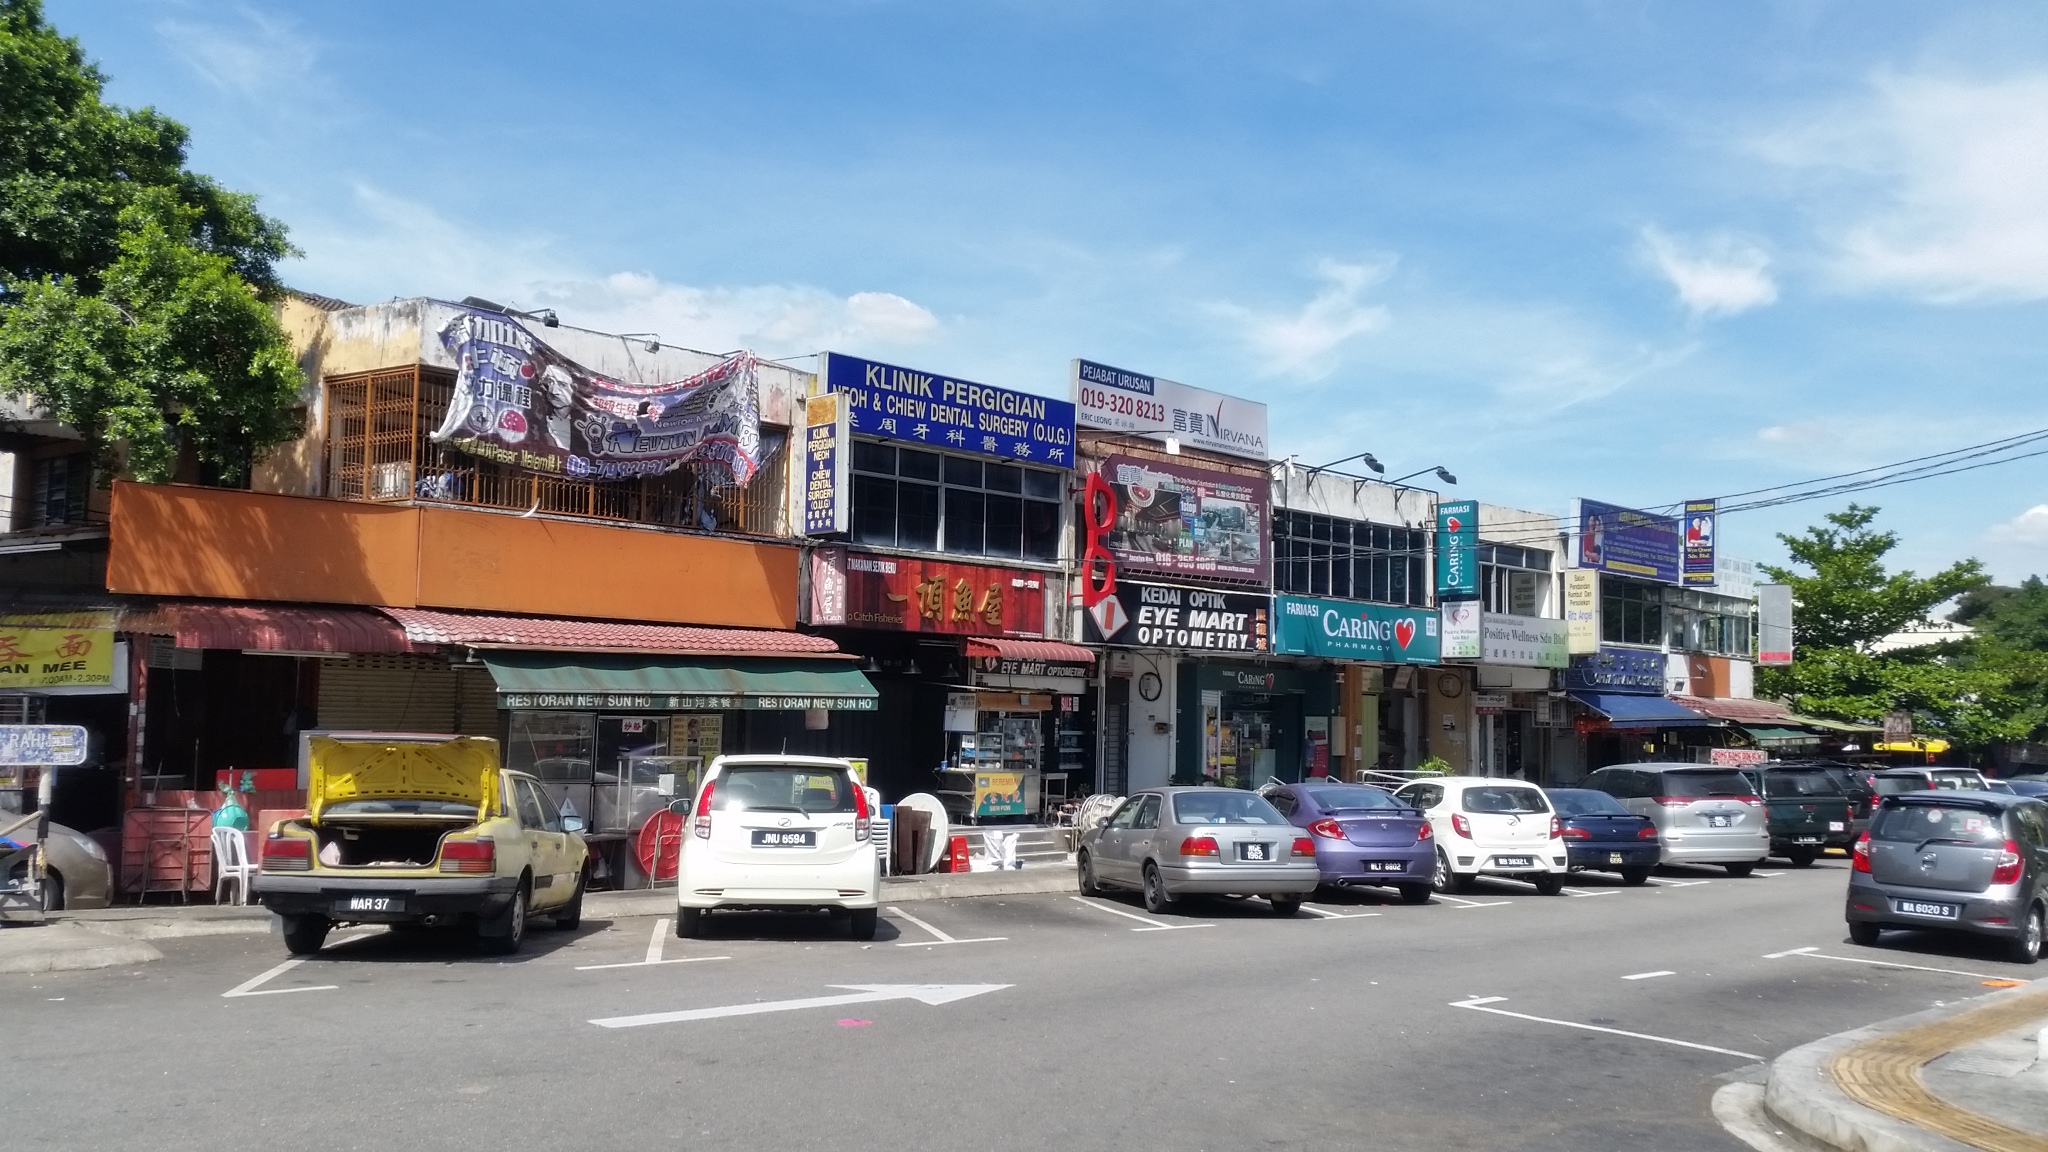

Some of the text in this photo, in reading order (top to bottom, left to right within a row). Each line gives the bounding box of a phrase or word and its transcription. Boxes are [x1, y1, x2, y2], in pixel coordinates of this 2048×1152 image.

[1083, 364, 1150, 392] PEJABAT URUSAN
[866, 364, 1045, 420] KLINIK PERGIGIAN
[1081, 387, 1164, 422] 019-320 8213
[873, 394, 881, 411] &
[887, 395, 925, 419] CHIEW
[931, 404, 975, 429] DENTAL
[979, 412, 1028, 438] SURGERY
[1081, 412, 1093, 422] ERIC
[1094, 414, 1112, 426] LEONG
[1172, 408, 1204, 436] 富貴
[813, 427, 830, 439] KLINIK
[808, 437, 836, 452] PERGIGIAN
[814, 450, 830, 461] NEOH
[818, 460, 824, 470] &
[812, 469, 830, 480] CHIEW
[1117, 464, 1141, 484] 富貴
[810, 479, 832, 490] DENTAL
[808, 488, 834, 500] SURGERY
[1440, 505, 1470, 516] FARMASI
[852, 558, 872, 572] MAKANAN
[873, 560, 885, 573] SEJUK
[886, 562, 896, 574] BEKU
[887, 574, 1002, 625] 一頂魚屋
[1141, 586, 1226, 610] KEDAI OPTIK
[1286, 602, 1318, 617] FARMASI
[1578, 610, 1592, 622] Angel
[854, 612, 874, 622] Catch
[874, 614, 903, 624] Fisheries
[1138, 606, 1248, 632] EYE MART
[1138, 627, 1249, 650] OPTOMETRY
[1484, 627, 1566, 645] Positive Wellness Sdn Bhd
[1328, 640, 1390, 650] PHARMACY
[42, 660, 87, 674] MEE
[1001, 662, 1086, 678] EYE MART OPTOMETRY
[506, 694, 650, 706] RESTORAN NEW SUN HO
[758, 697, 872, 708] RESTORAN NEW SUN HO
[1966, 820, 1982, 830] P
[762, 833, 806, 844] JNU 6594
[350, 897, 389, 910] WAR 37
[1902, 902, 1950, 916] WA 6020 S
